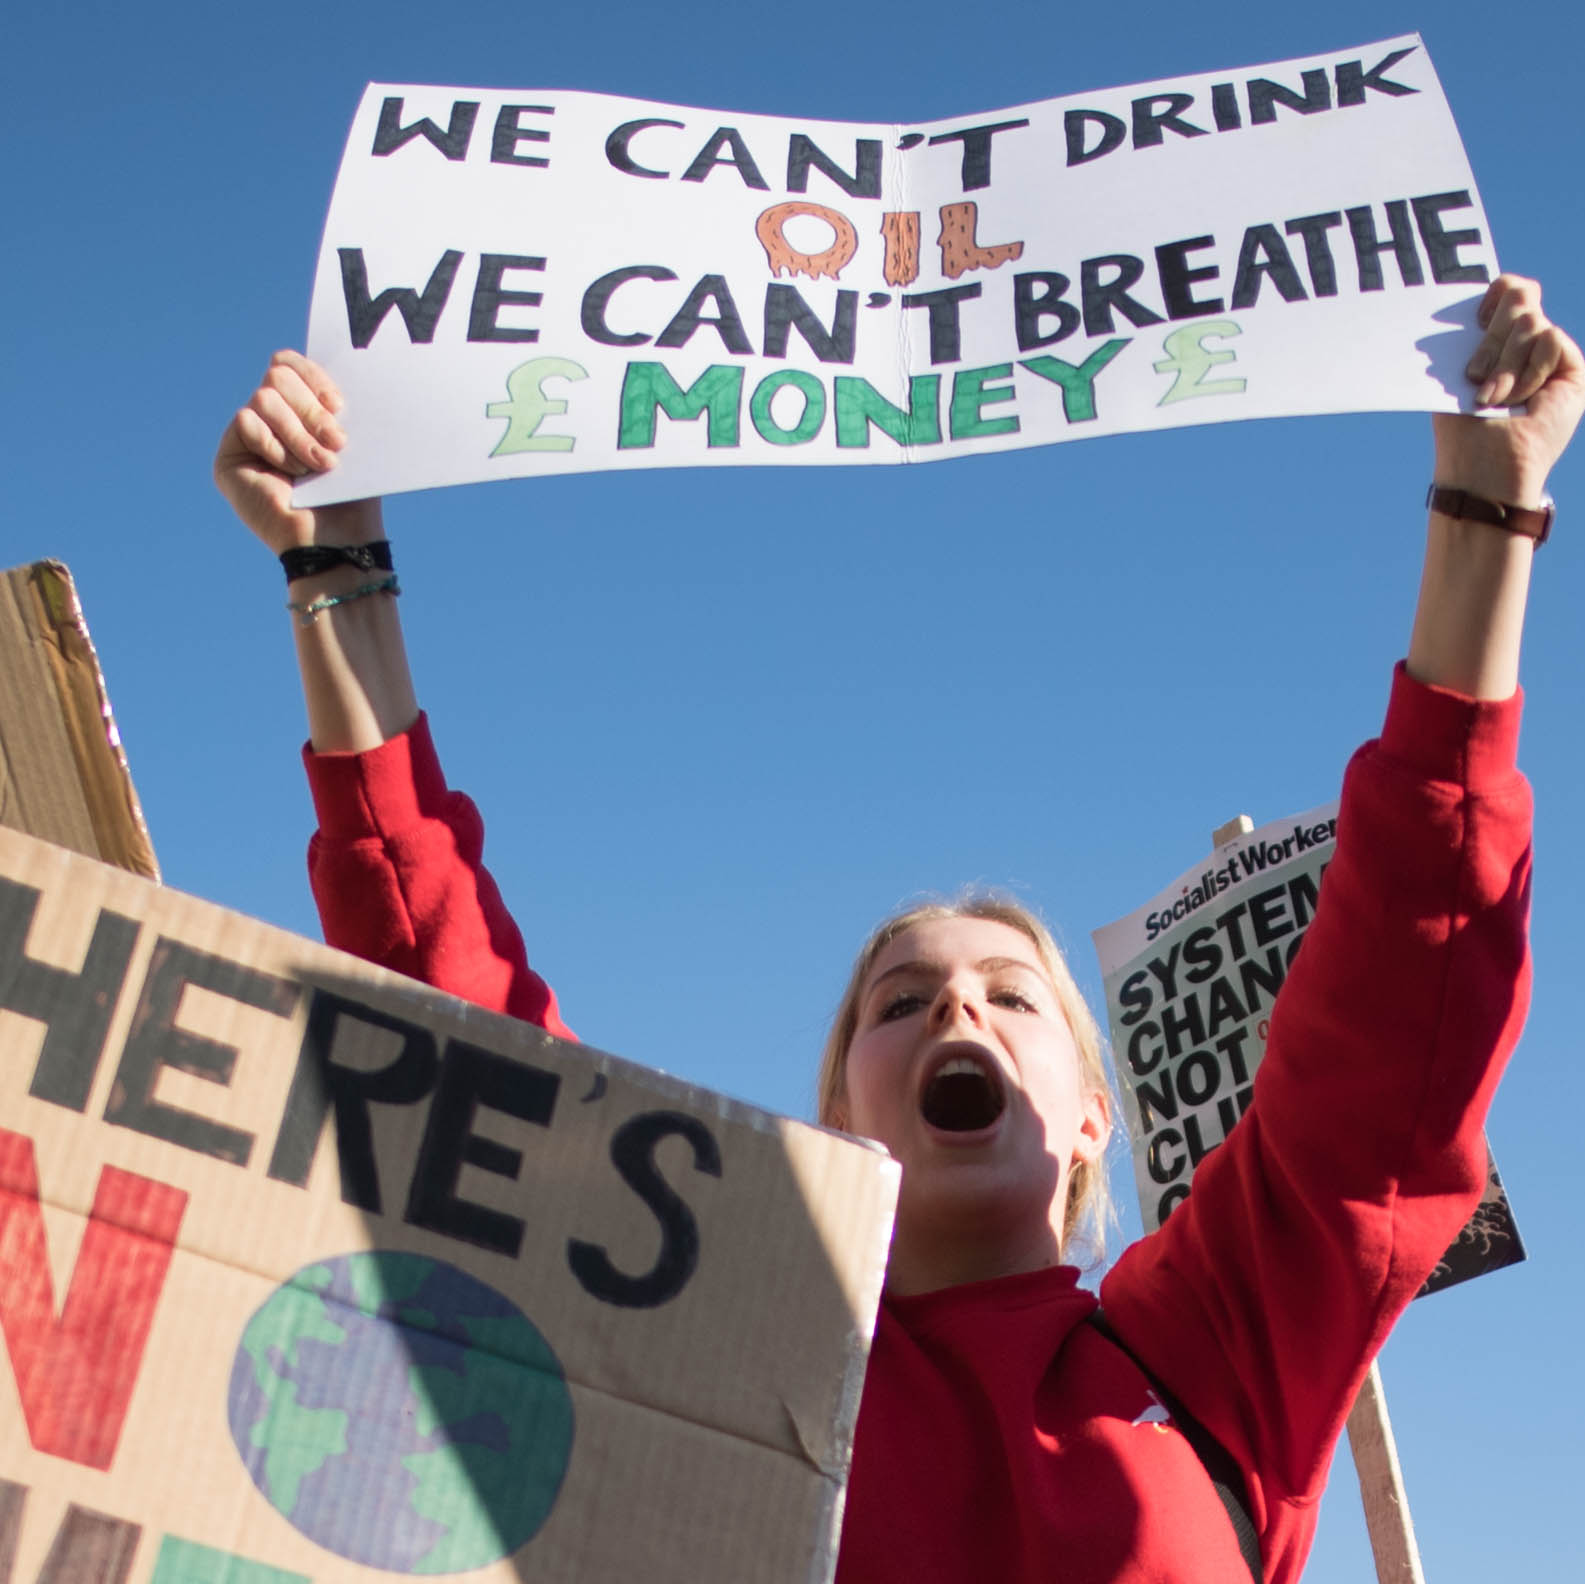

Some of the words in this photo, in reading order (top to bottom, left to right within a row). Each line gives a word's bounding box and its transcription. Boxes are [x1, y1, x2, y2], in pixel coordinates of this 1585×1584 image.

[371, 96, 555, 168] WE
[604, 116, 1031, 199] CAN'T
[1064, 46, 1422, 167] DRINK
[338, 247, 547, 349] WE
[578, 262, 983, 366] CAN'T
[1012, 190, 1493, 352] BREATHE
[754, 199, 1025, 287] OIL
[618, 337, 1134, 451] MONEY
[1145, 851, 1242, 941] Socialist
[1127, 933, 1305, 1077] CHAN
[1136, 1025, 1249, 1135] NOT
